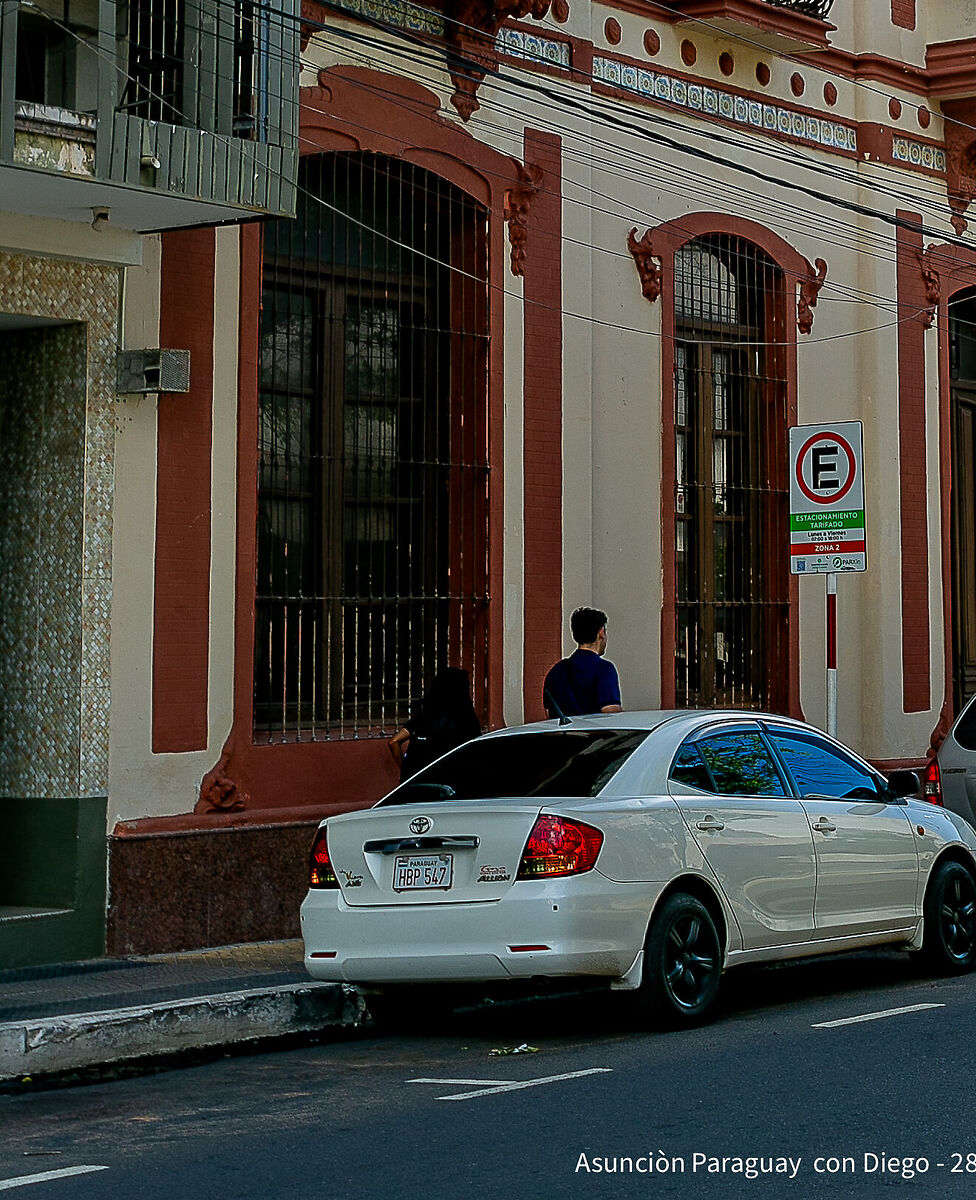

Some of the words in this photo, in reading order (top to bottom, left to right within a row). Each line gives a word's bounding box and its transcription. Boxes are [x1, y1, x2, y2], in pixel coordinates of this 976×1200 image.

[811, 446, 840, 490] E
[795, 511, 859, 523] ESTACIONAMIENTO
[809, 520, 844, 530] TARIFADO
[814, 544, 835, 552] ZONA
[398, 868, 421, 886] HBP
[424, 867, 446, 885] 547
